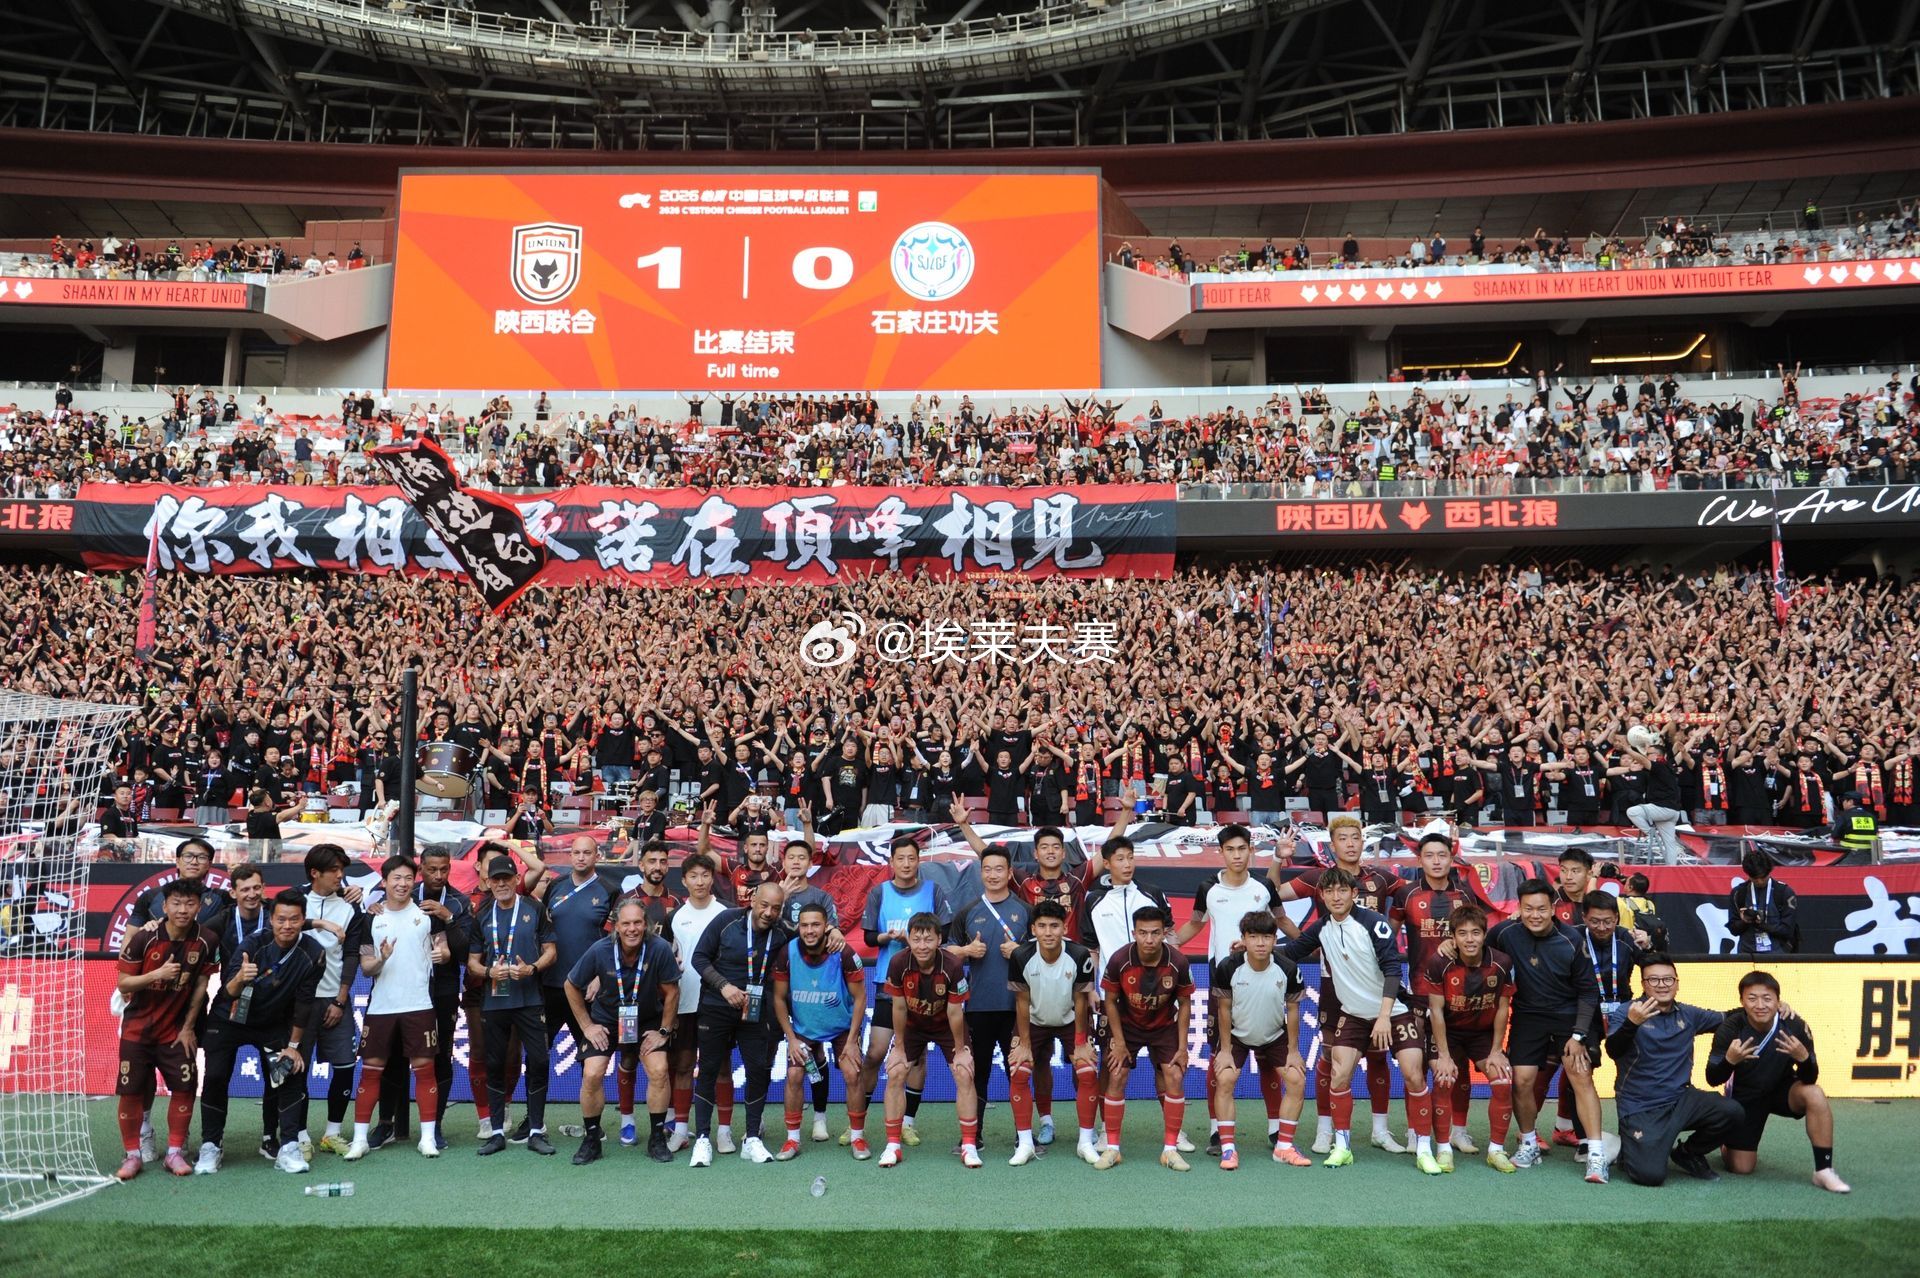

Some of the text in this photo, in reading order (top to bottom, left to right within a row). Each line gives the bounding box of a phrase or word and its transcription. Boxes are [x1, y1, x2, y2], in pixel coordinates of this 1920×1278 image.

[528, 238, 566, 249] UNION
[637, 246, 682, 289] 1
[792, 246, 854, 290] 0
[63, 284, 119, 300] SHAANXI
[124, 285, 136, 300] IN
[141, 286, 161, 301] MY
[167, 287, 207, 303] HEART
[1239, 287, 1272, 304] FEAR
[1473, 269, 1773, 297] SHAANXI IN MY HEART UNION WITHOUT FEAR
[494, 308, 597, 334] 陕西联合
[870, 309, 999, 335] 石家庄功夫
[693, 329, 796, 355] 比赛结束
[707, 363, 780, 378] Full time
[0, 503, 74, 531] 北狼
[1276, 503, 1389, 531] 陕西队
[1445, 499, 1558, 528] 西北狼
[1697, 495, 1774, 526] We
[1777, 488, 1867, 524] Are
[424, 1030, 438, 1048] 18
[1396, 1022, 1418, 1041] 36
